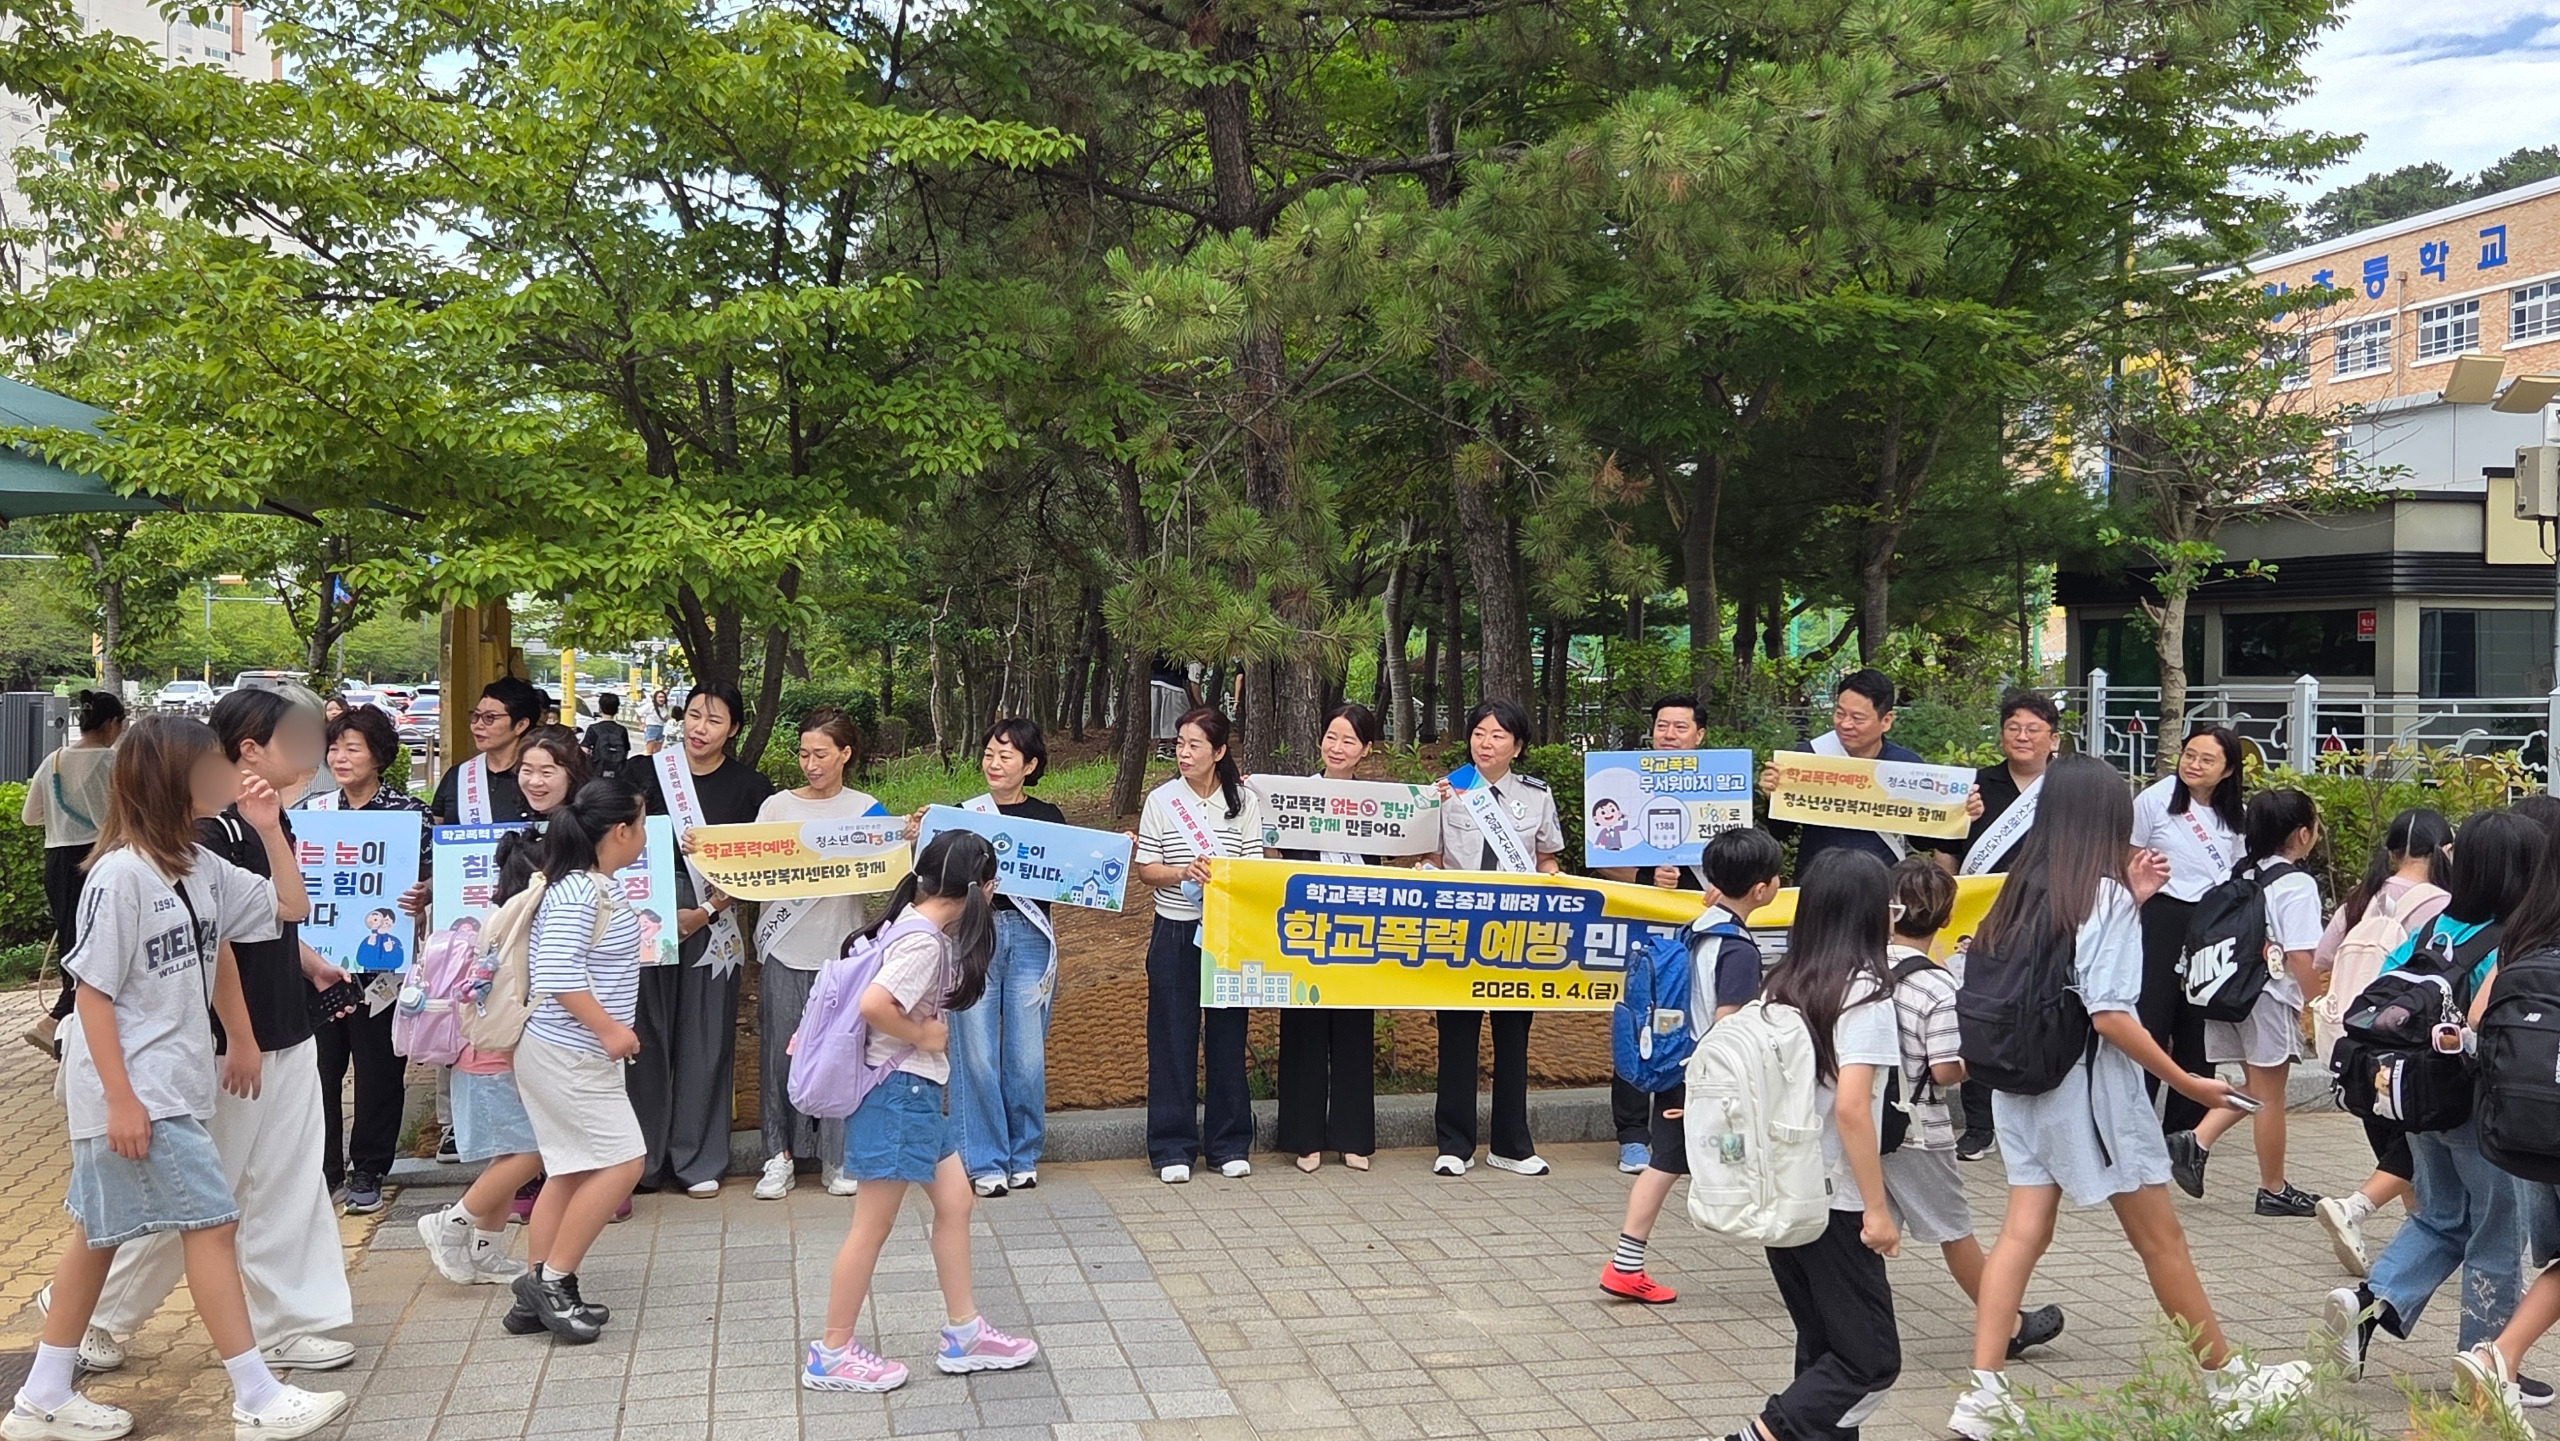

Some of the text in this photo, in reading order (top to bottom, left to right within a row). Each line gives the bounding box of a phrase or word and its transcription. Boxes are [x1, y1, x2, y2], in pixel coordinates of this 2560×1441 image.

[1639, 756, 1698, 773] 학교폭력
[1640, 774, 1746, 792] 무서워하지 말고
[1786, 767, 1872, 789] 학교폭력예방,
[1887, 776, 1918, 789] 청소년
[1934, 781, 1968, 796] 1388
[1270, 793, 1415, 820] 학교폭력 없는 경남!
[1783, 792, 1947, 822] 청소년상담복지센터와 함께
[441, 828, 491, 841] 학교폭력
[1277, 815, 1406, 838] 우리 함께 만들어요.
[1655, 821, 1675, 832] 1388
[702, 838, 800, 861] 학교폭력예방,
[816, 834, 850, 848] 청소년
[1016, 841, 1046, 860] 눈이
[335, 841, 386, 865] 눈이
[854, 860, 887, 878] 함께
[1018, 863, 1065, 883] 됩니다.
[333, 871, 384, 896] 힘이
[1306, 883, 1586, 914] 학교폭력 NO, 존중과 배려 YES
[302, 902, 339, 927] 다
[1281, 909, 1470, 965] 학교폭력
[1478, 919, 1575, 966] 예방
[2188, 936, 2237, 990] NIKE
[1471, 980, 1620, 1001] 2026. 9. 4.(금)
